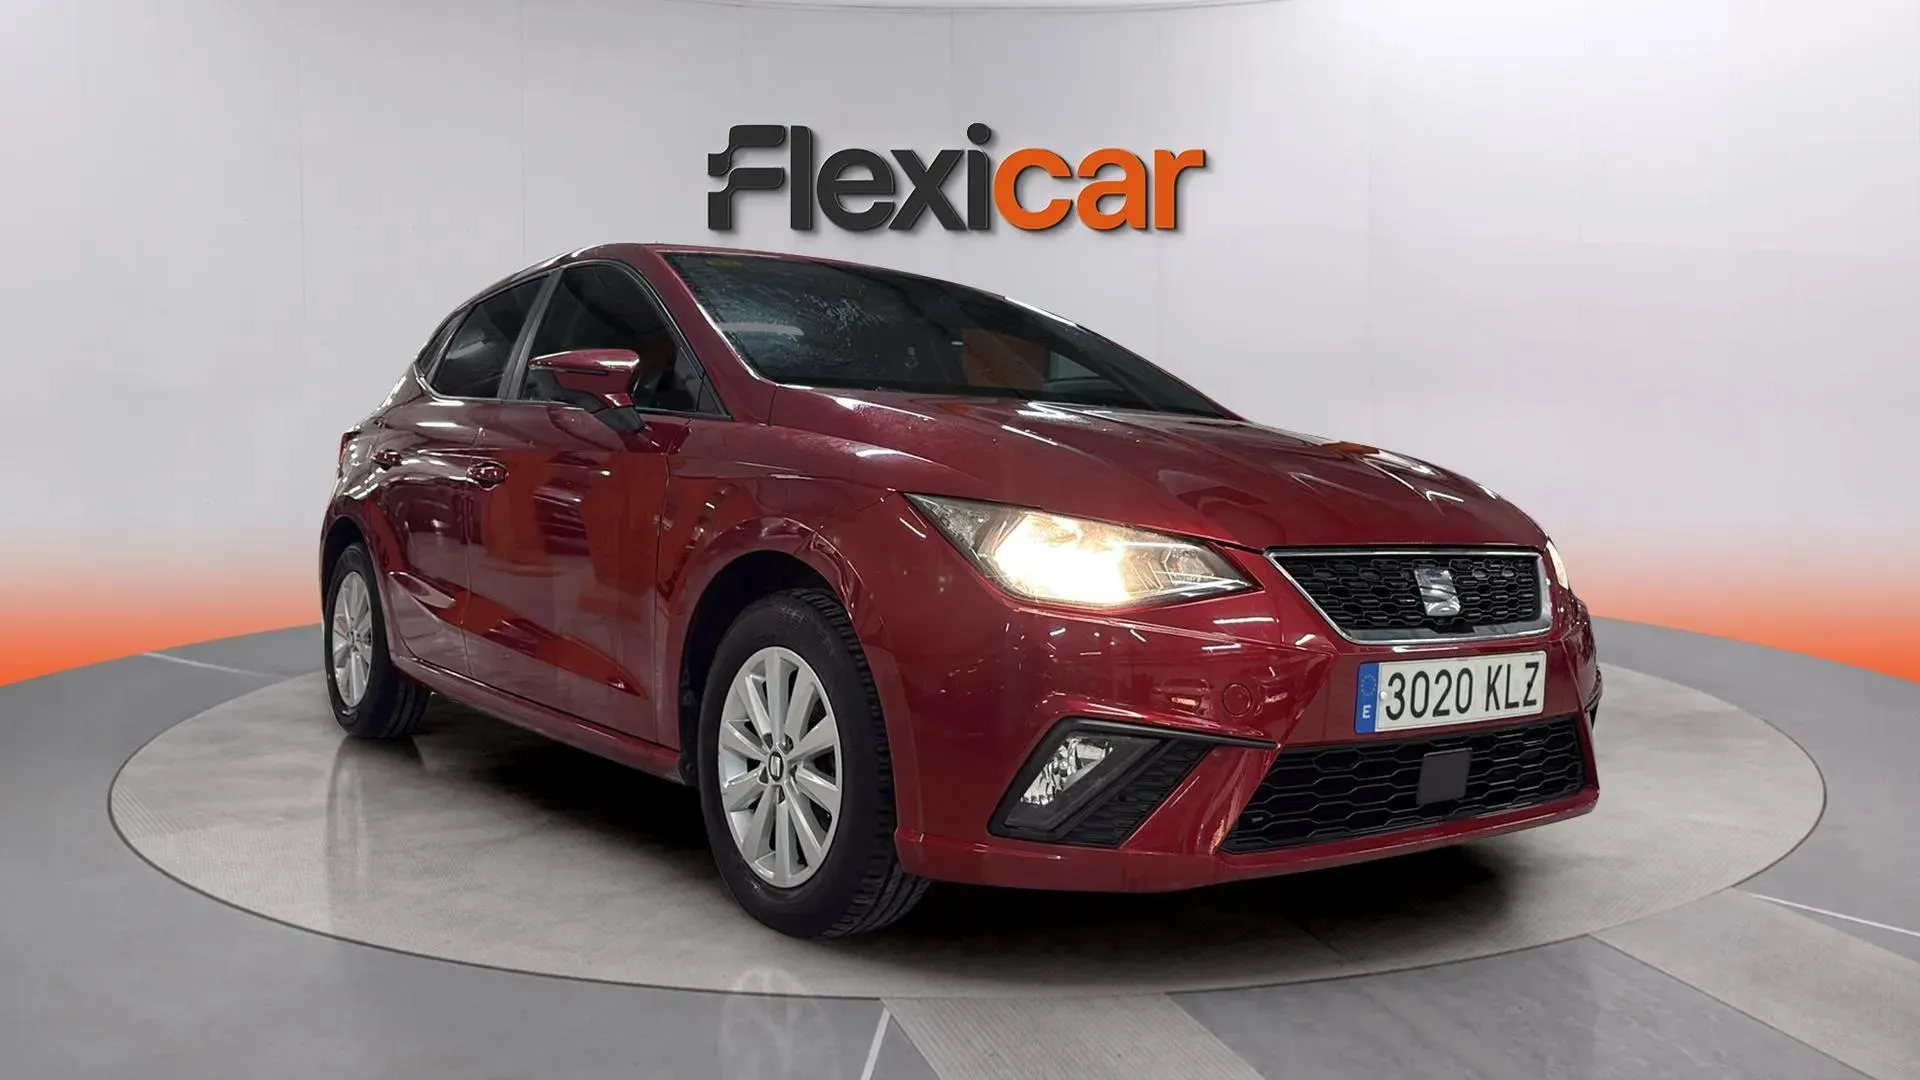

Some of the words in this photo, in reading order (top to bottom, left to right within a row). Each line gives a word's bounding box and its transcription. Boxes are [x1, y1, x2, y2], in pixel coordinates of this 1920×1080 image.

[707, 122, 1205, 230] Flexicar
[1362, 704, 1372, 719] E
[1385, 667, 1474, 721] 3020
[1485, 661, 1540, 712] KLZ
